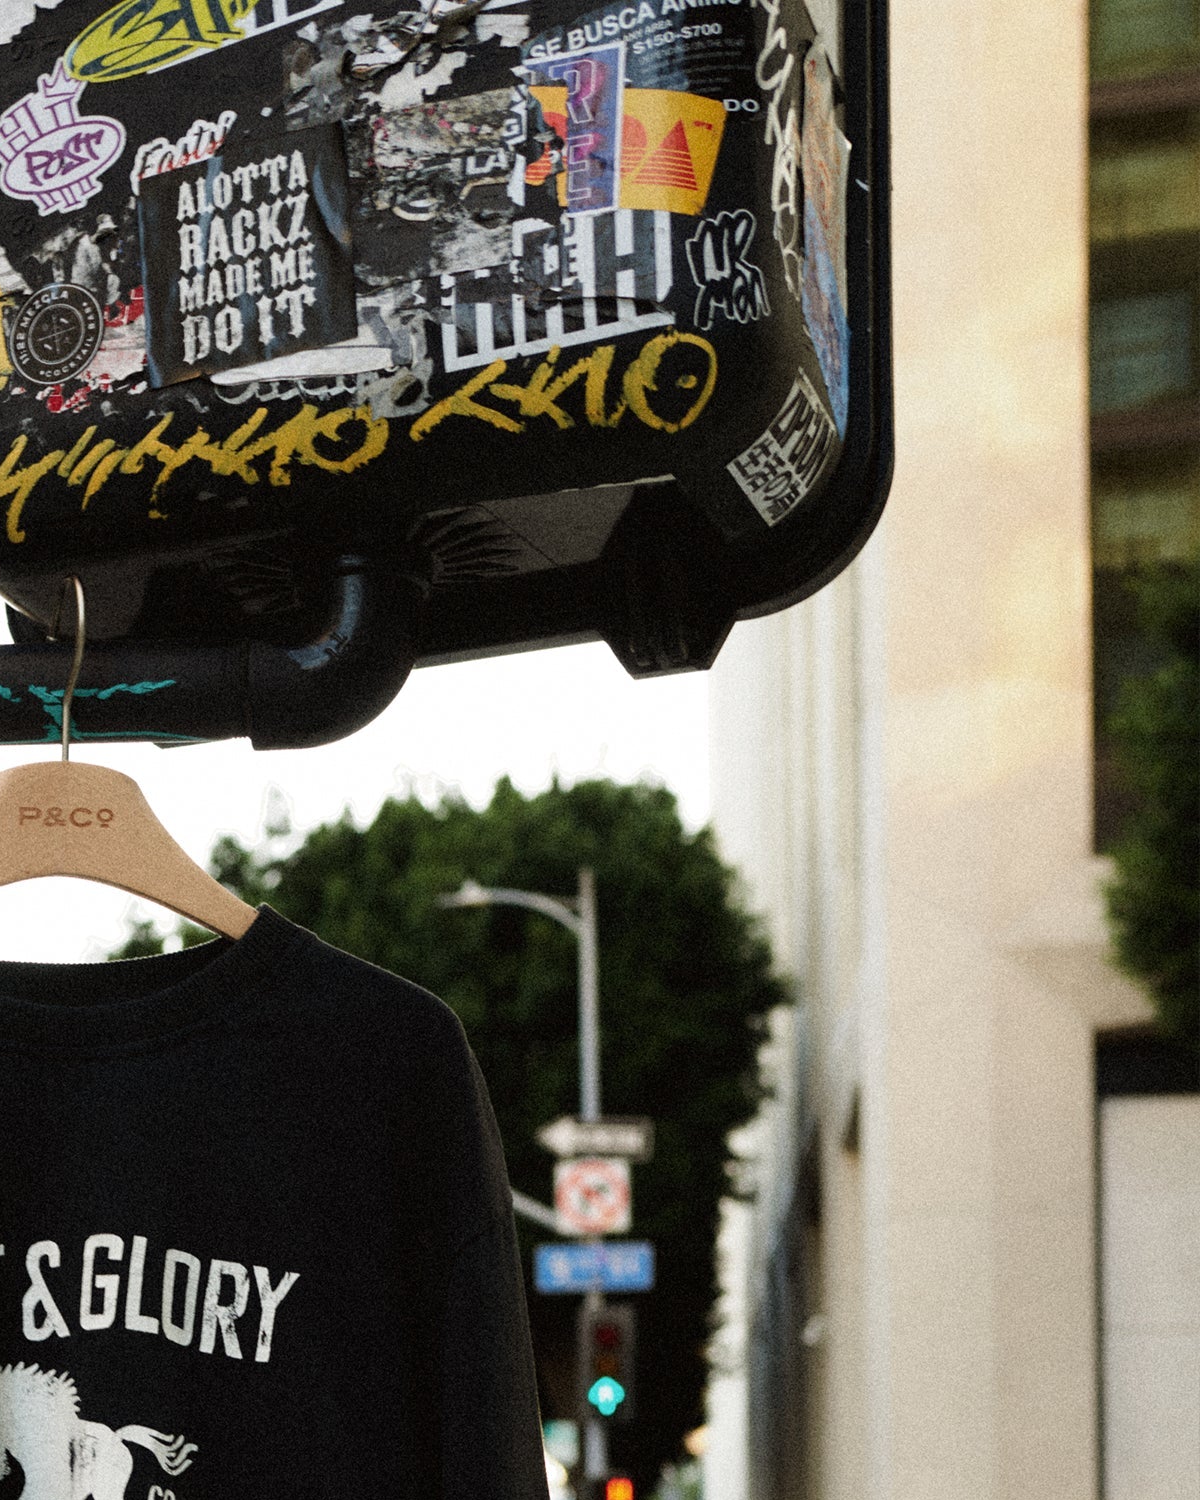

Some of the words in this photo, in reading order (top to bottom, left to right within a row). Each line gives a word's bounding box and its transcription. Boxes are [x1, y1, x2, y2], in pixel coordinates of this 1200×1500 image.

[530, 36, 565, 59] SE
[566, 1, 657, 51] BUSCA
[176, 149, 309, 222] ALOTTA
[177, 189, 312, 274] RACKZ
[20, 290, 69, 328] MEZCLA
[178, 256, 265, 314] MADE
[269, 242, 317, 290] ME
[44, 336, 95, 378] COCKTAIL
[181, 304, 244, 365] DO
[256, 284, 317, 345] IT
[22, 1240, 71, 1342] &
[80, 1233, 301, 1363] GLORY
